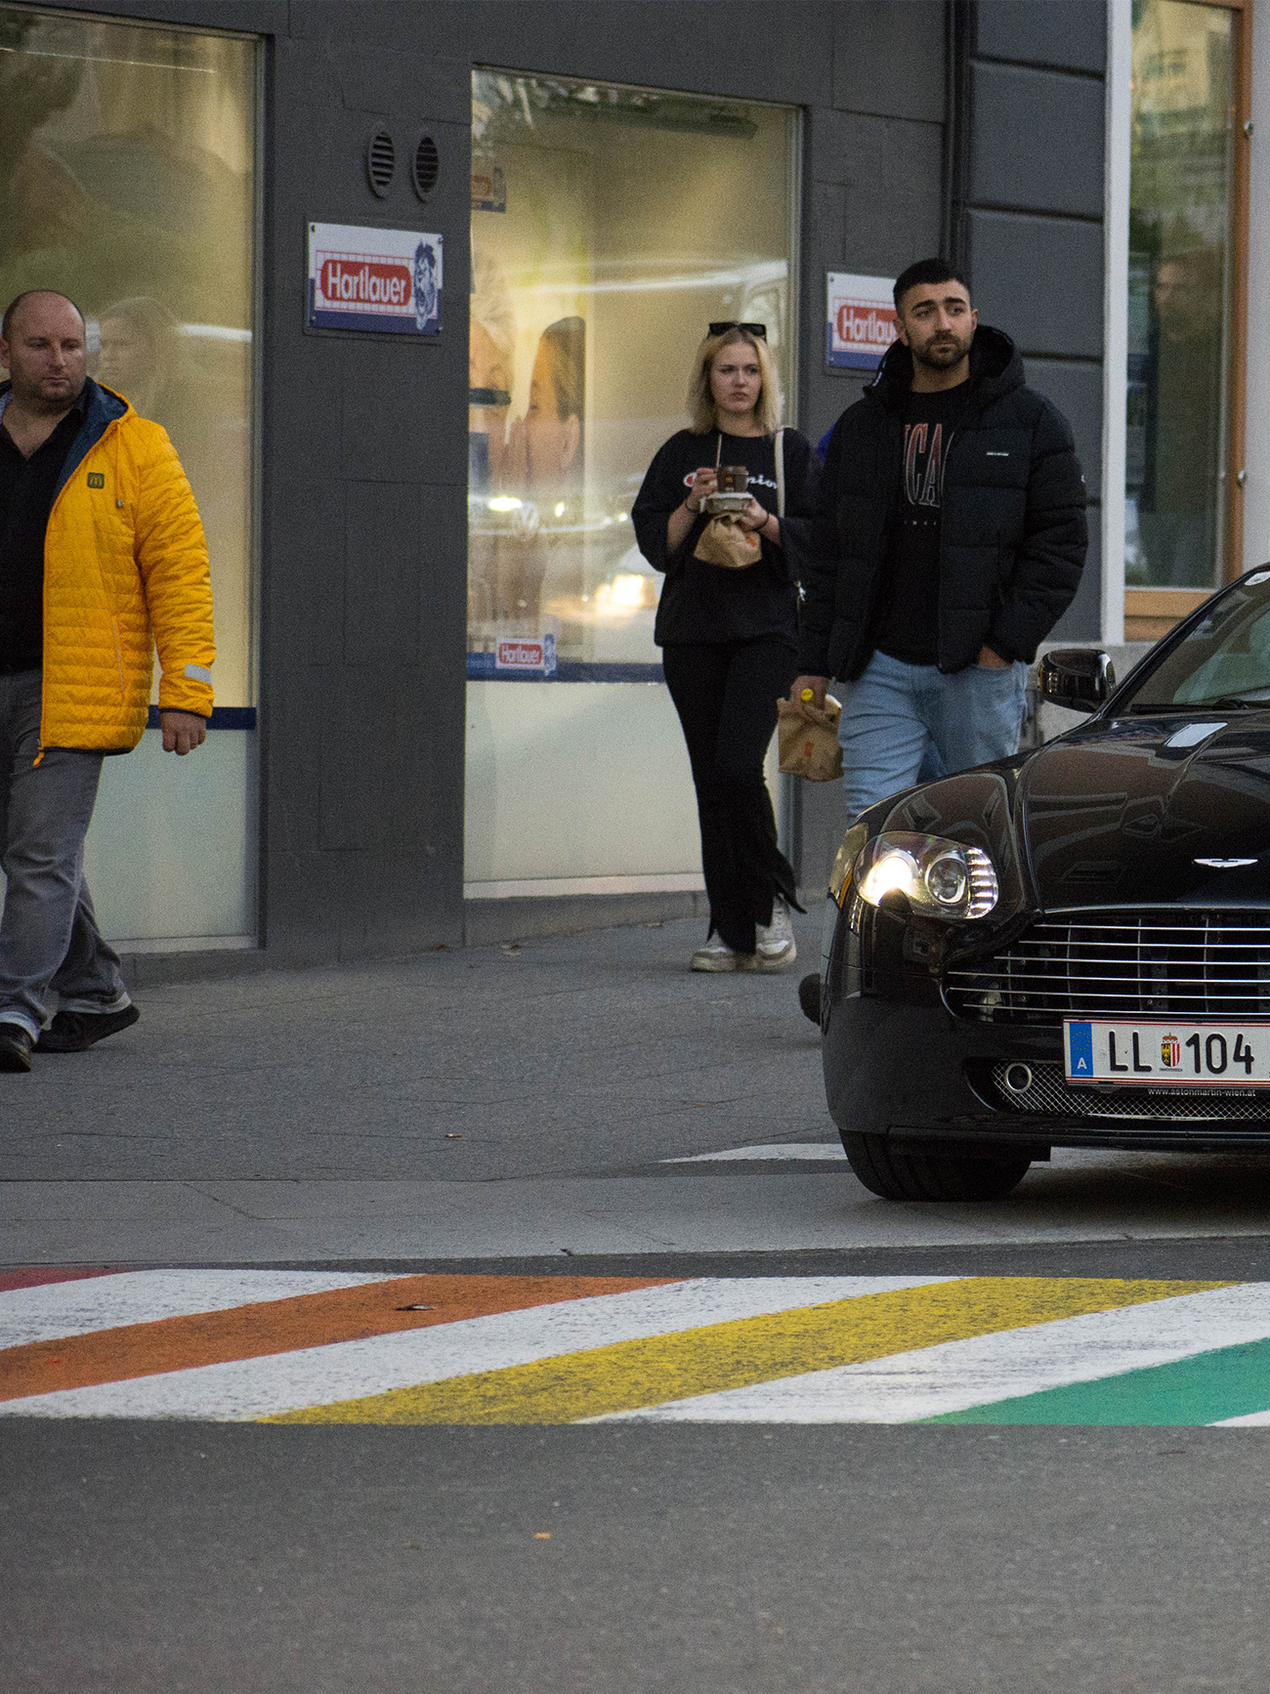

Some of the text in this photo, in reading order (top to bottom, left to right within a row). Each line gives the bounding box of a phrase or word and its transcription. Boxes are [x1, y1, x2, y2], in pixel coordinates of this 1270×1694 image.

[327, 262, 407, 304] Hartlauer
[842, 307, 896, 344] Hartlau
[1077, 1057, 1087, 1070] A
[1109, 1030, 1152, 1072] LL
[1185, 1033, 1255, 1075] 104
[1148, 1087, 1256, 1097] www.astonmartin-wien.at
